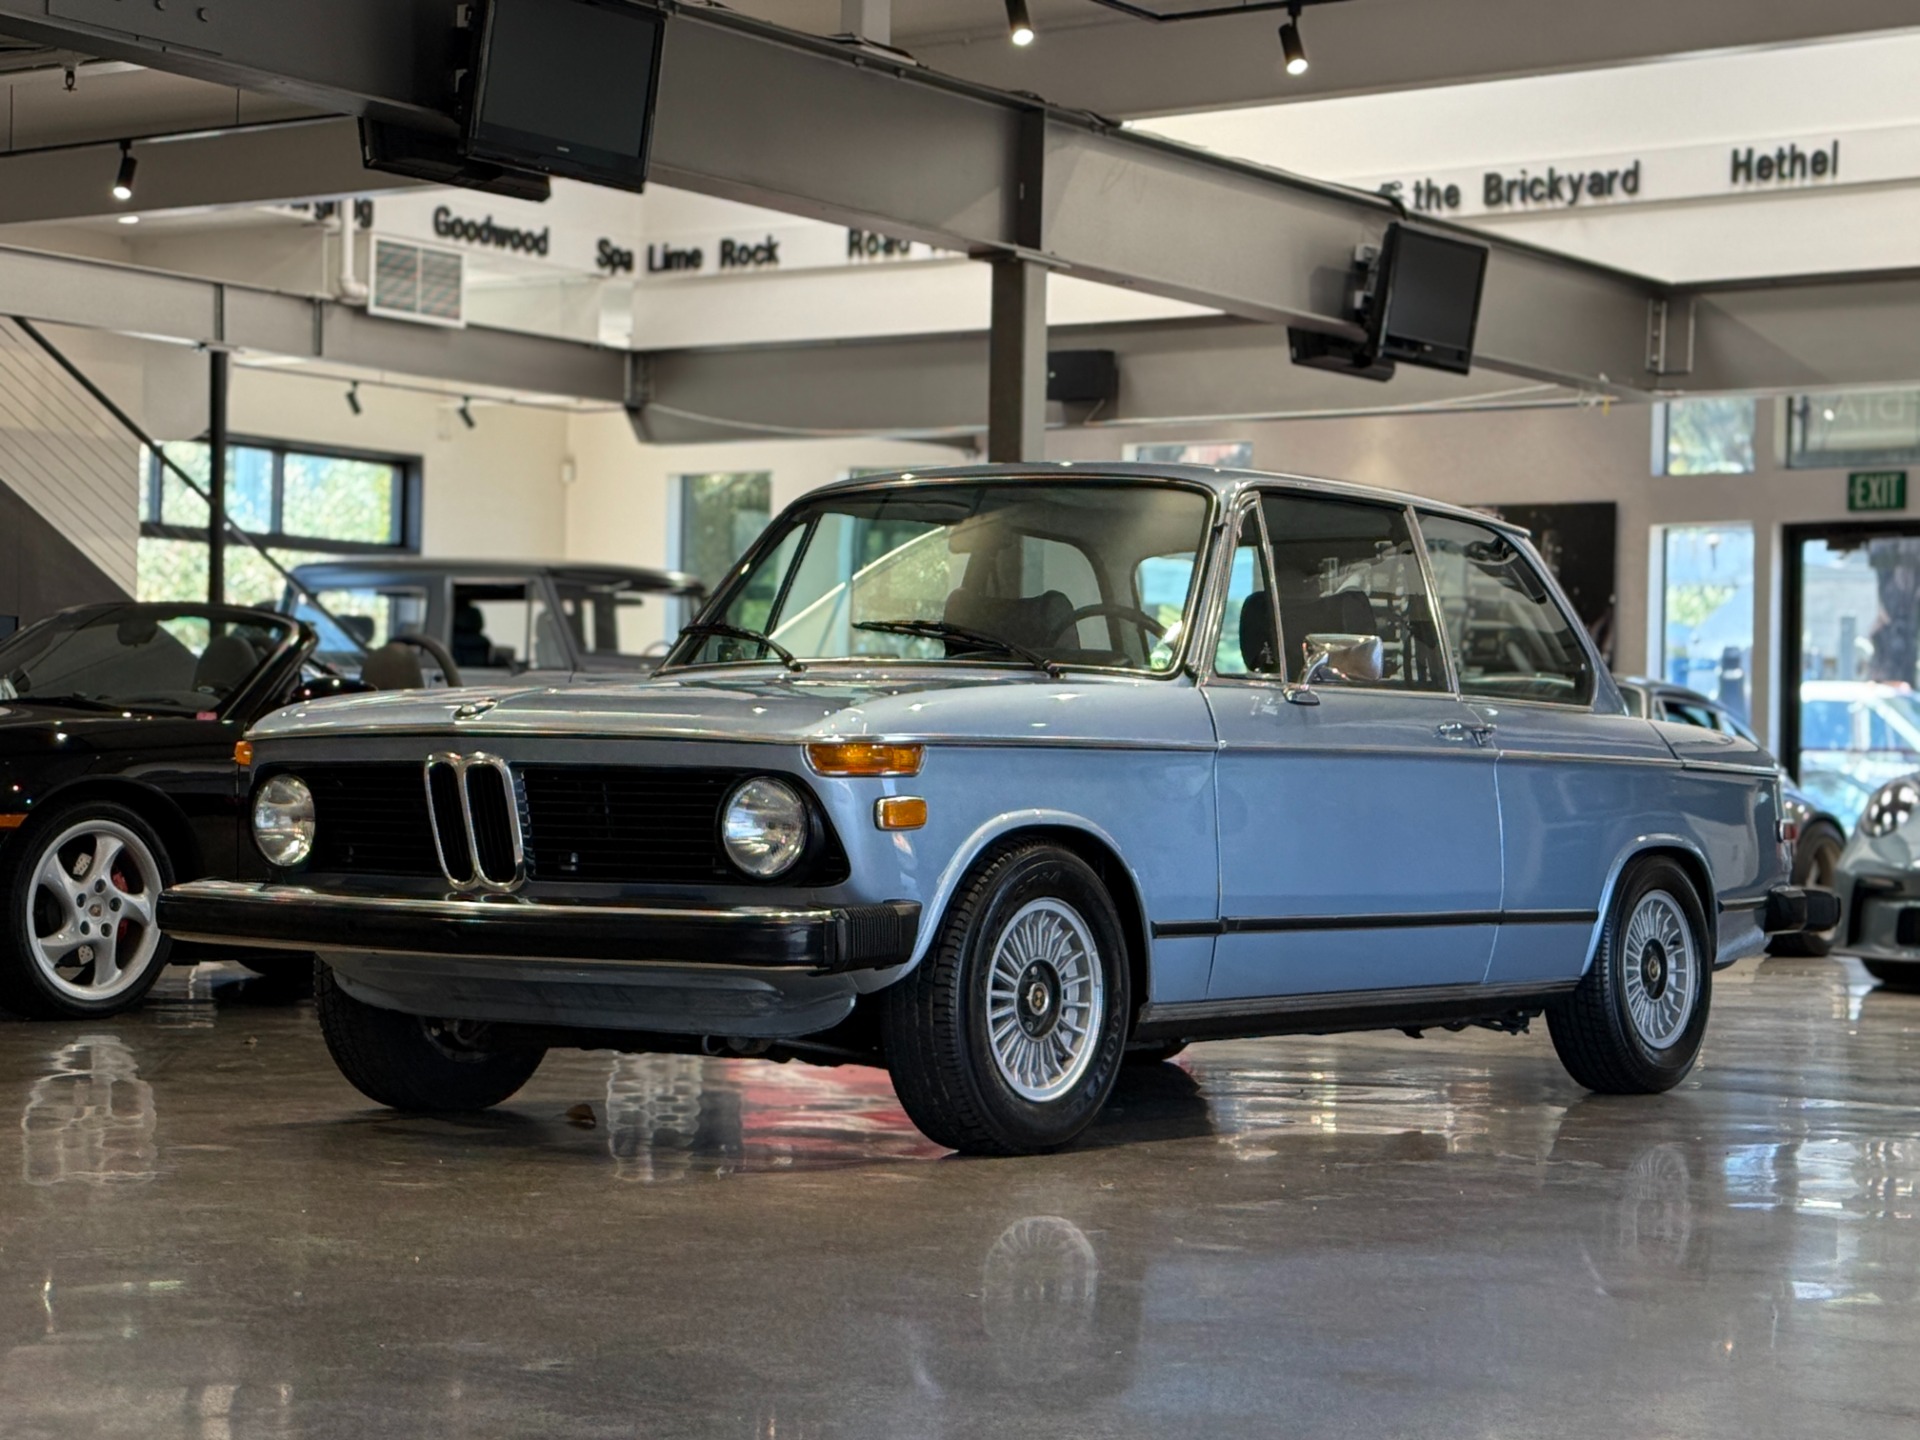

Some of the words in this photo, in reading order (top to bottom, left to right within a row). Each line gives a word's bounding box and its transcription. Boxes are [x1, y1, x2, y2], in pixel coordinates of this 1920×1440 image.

[1731, 139, 1839, 184] Hethel
[1413, 177, 1461, 211] the
[1483, 159, 1641, 208] Brickyard
[433, 204, 549, 256] Goodwood
[596, 237, 634, 276] Spa
[647, 241, 703, 273] Lime
[720, 234, 780, 268] Rock
[1854, 474, 1902, 508] EXIT
